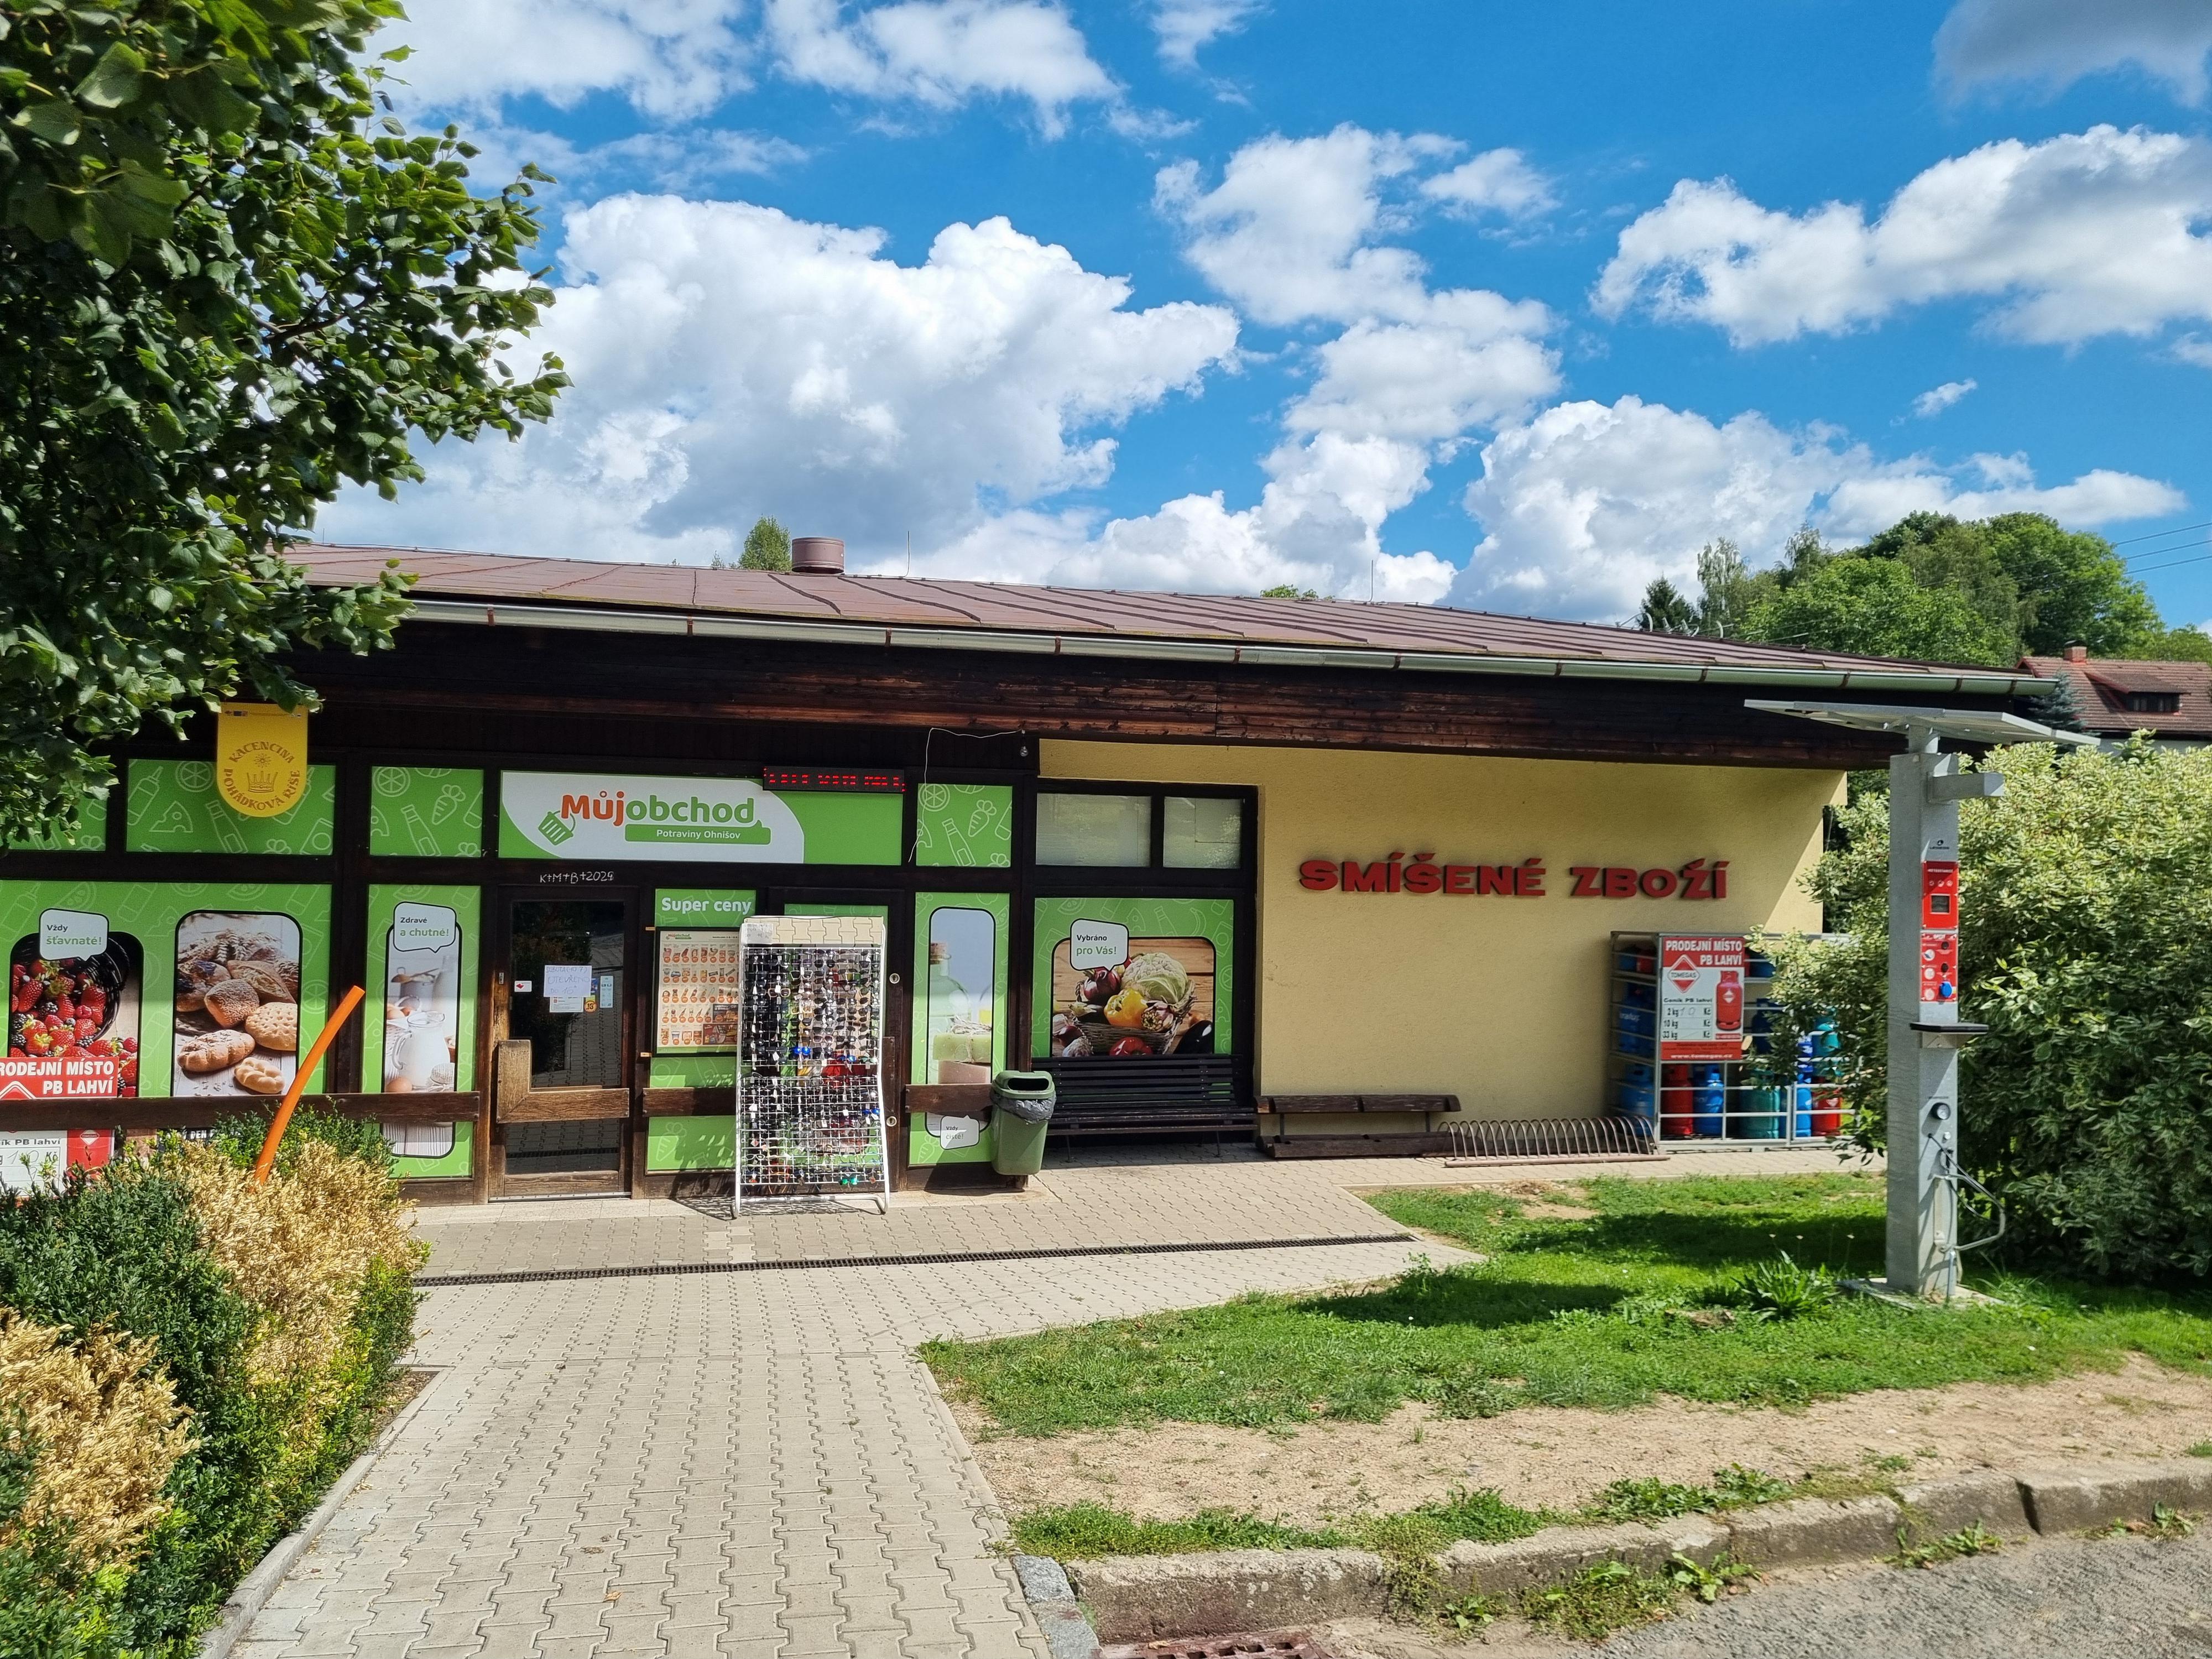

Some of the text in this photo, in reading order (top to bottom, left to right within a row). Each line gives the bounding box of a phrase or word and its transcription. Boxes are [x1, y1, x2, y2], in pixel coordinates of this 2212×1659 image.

[223, 768, 300, 810] POHÁDKOVÁ ŘÍŠE
[561, 791, 754, 826] Můjobchod
[656, 830, 740, 839] Potraviny Ohnišov
[1299, 852, 1730, 899] SMÍŠENÉ ZBOŽÍ
[661, 897, 752, 915] Super ceny
[46, 924, 68, 933] Vždy
[409, 928, 449, 936] chutné!
[46, 935, 102, 945] šťavnaté!
[1076, 934, 1107, 942] Vybráno
[1665, 938, 1743, 951] PRODEJNÍ MÍSTO
[1076, 946, 1117, 956] pro Vás!
[1700, 952, 1743, 965] PB LAHVÍ
[1672, 1008, 1679, 1018] kg
[1672, 1019, 1678, 1029] kg
[1671, 1031, 1677, 1040] kg
[0, 1058, 114, 1077] RODEJNÍ MÍSTO
[43, 1077, 114, 1094] PB LAHVÍ
